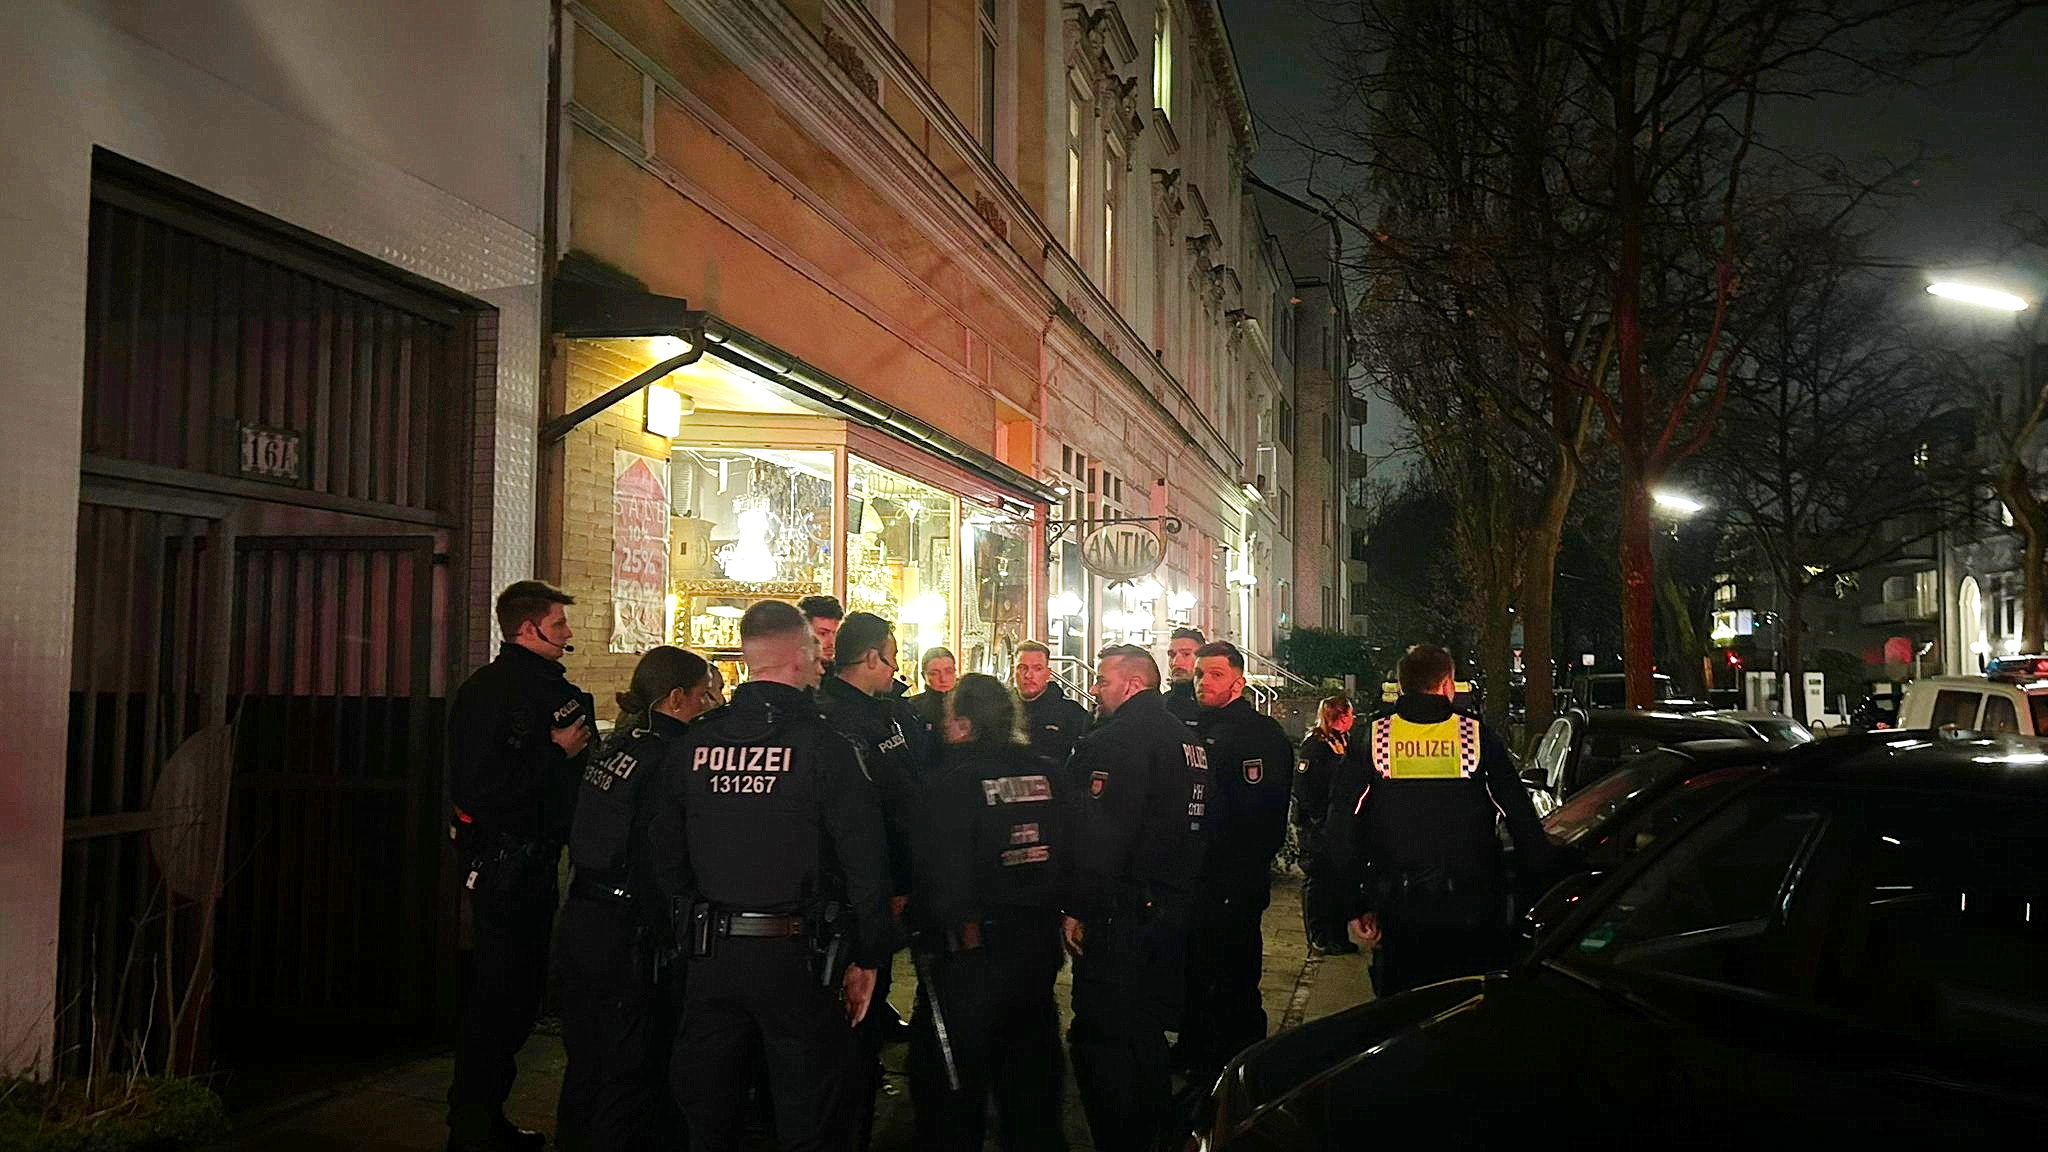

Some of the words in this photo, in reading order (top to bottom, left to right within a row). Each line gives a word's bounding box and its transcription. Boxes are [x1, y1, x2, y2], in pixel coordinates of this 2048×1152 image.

[622, 547, 656, 574] 25%
[1087, 530, 1158, 568] ANTIK
[692, 747, 792, 772] POLIZEI
[1394, 740, 1455, 758] POLIZEI
[709, 775, 777, 794] 131267
